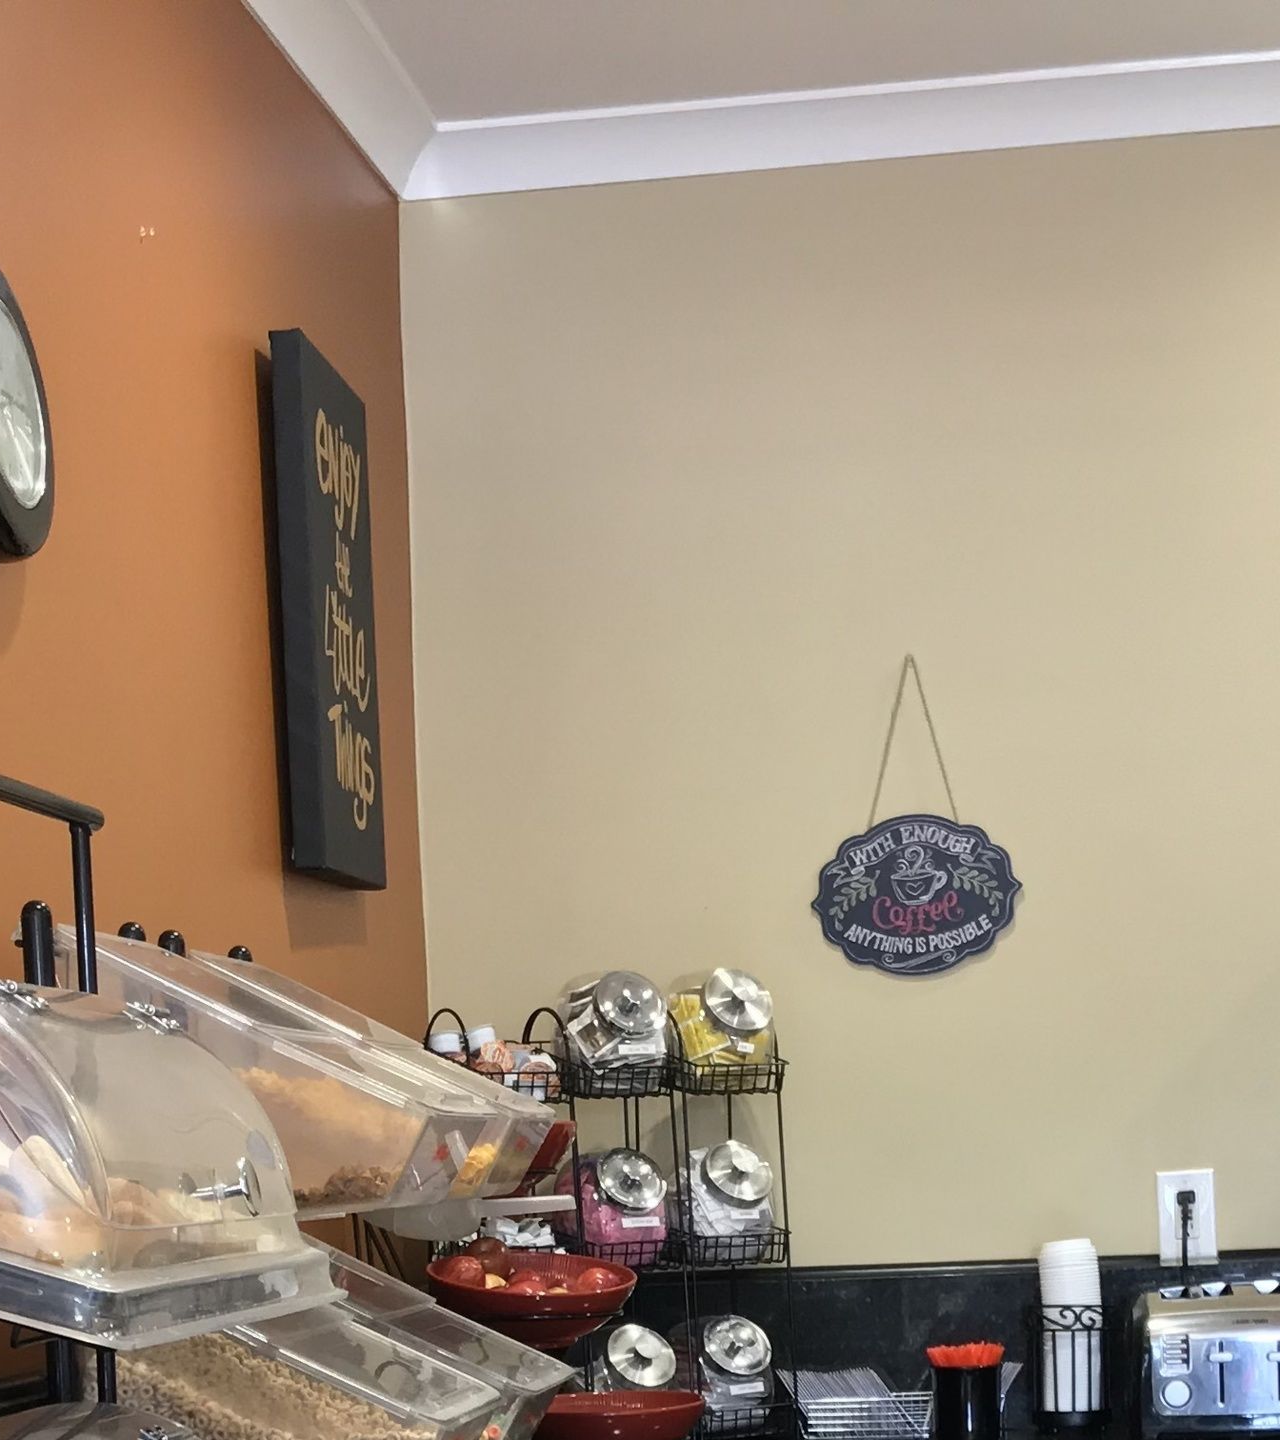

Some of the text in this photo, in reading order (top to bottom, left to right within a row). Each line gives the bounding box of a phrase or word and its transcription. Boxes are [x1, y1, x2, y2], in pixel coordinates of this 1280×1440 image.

[849, 825, 976, 868] WITH ENOUGH
[843, 913, 994, 954] ANYTHING IS POSSIBLE
[871, 890, 965, 935] Coffee
